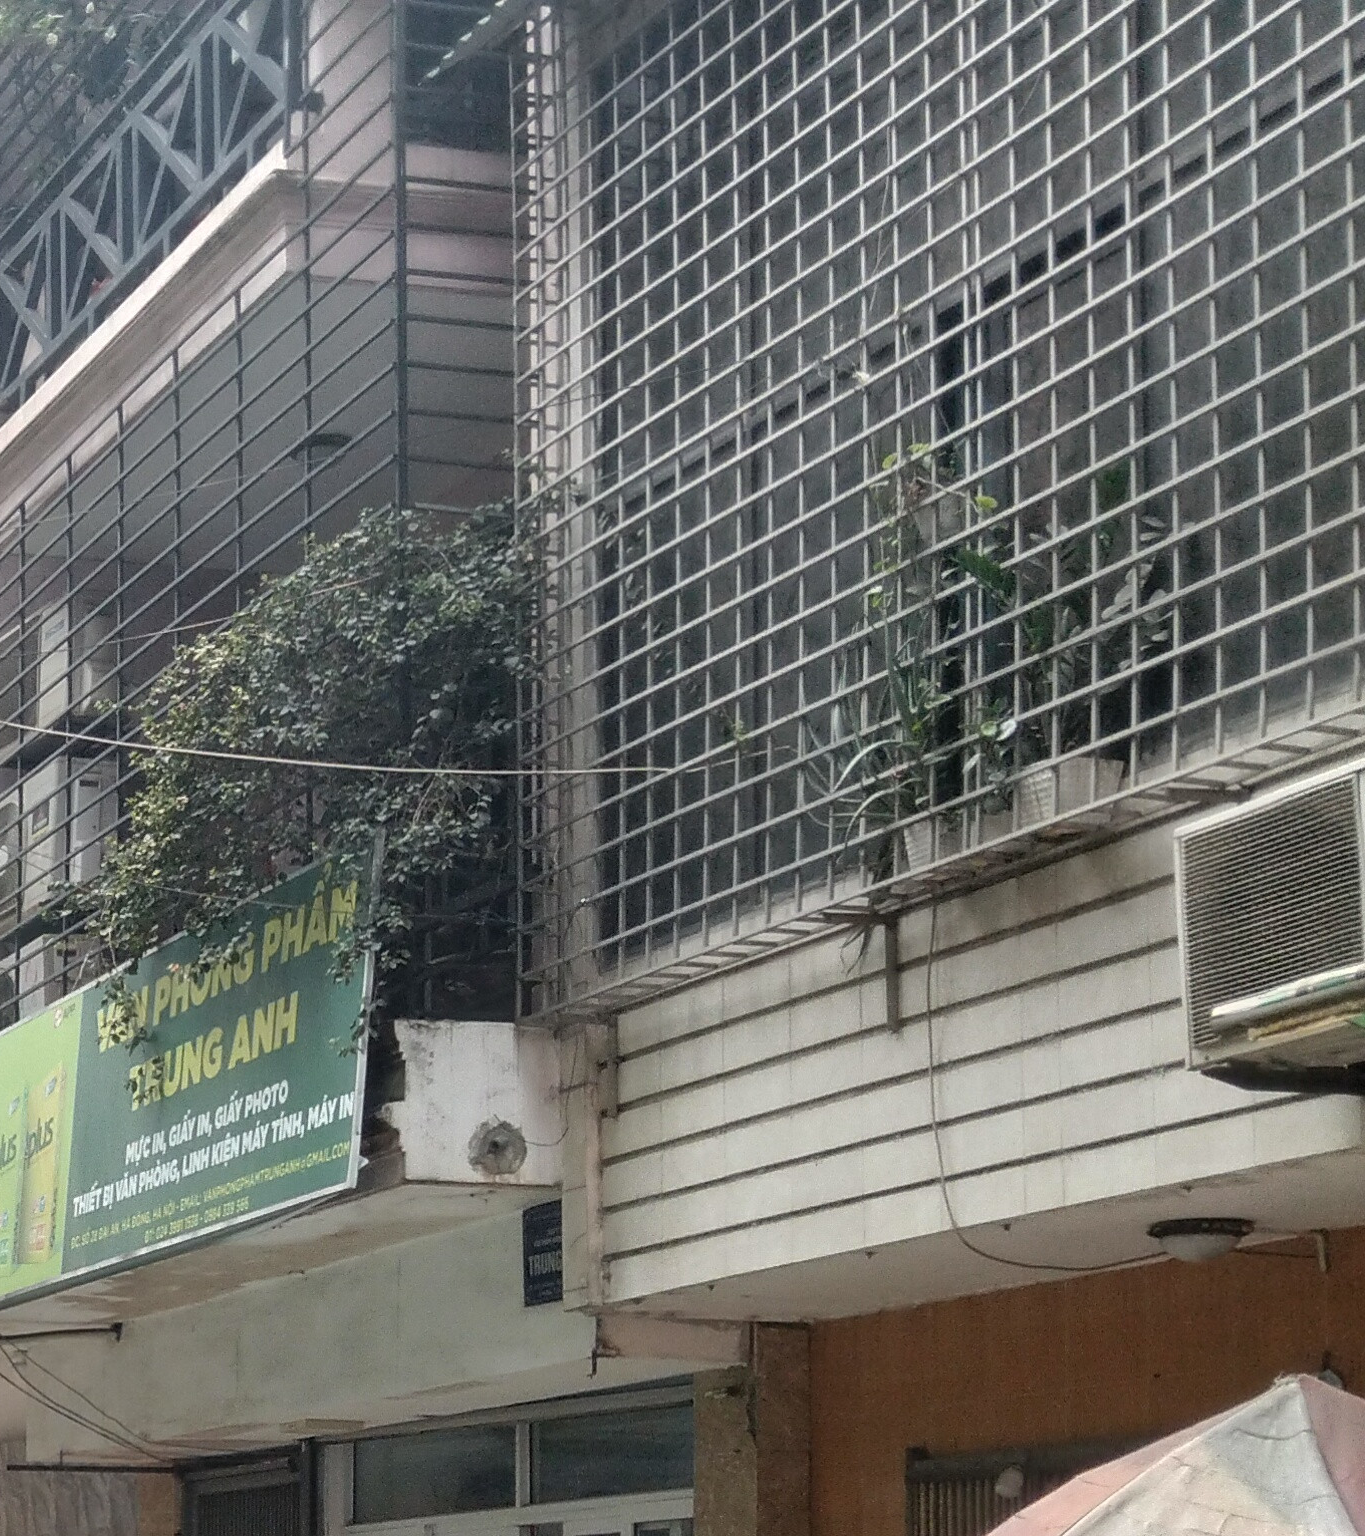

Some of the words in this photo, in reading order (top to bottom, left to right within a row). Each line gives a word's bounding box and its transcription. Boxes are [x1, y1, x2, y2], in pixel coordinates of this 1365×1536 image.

[97, 985, 149, 1053] VN
[227, 991, 298, 1070] ANH
[73, 1181, 102, 1217] THIẾT
[181, 1146, 209, 1177] LINH
[210, 1133, 240, 1166] KIỆN
[241, 1120, 269, 1155] MÁY
[271, 1111, 305, 1143] TÍNH,
[307, 1095, 337, 1130] MÁY
[338, 1091, 355, 1120] IN
[125, 1135, 150, 1166] MỰC
[152, 1130, 167, 1154] IN,
[169, 1109, 196, 1147] GIẤY
[197, 1111, 212, 1137] IN,
[214, 1090, 243, 1130] GIẤY
[244, 1079, 289, 1118] PHOTO
